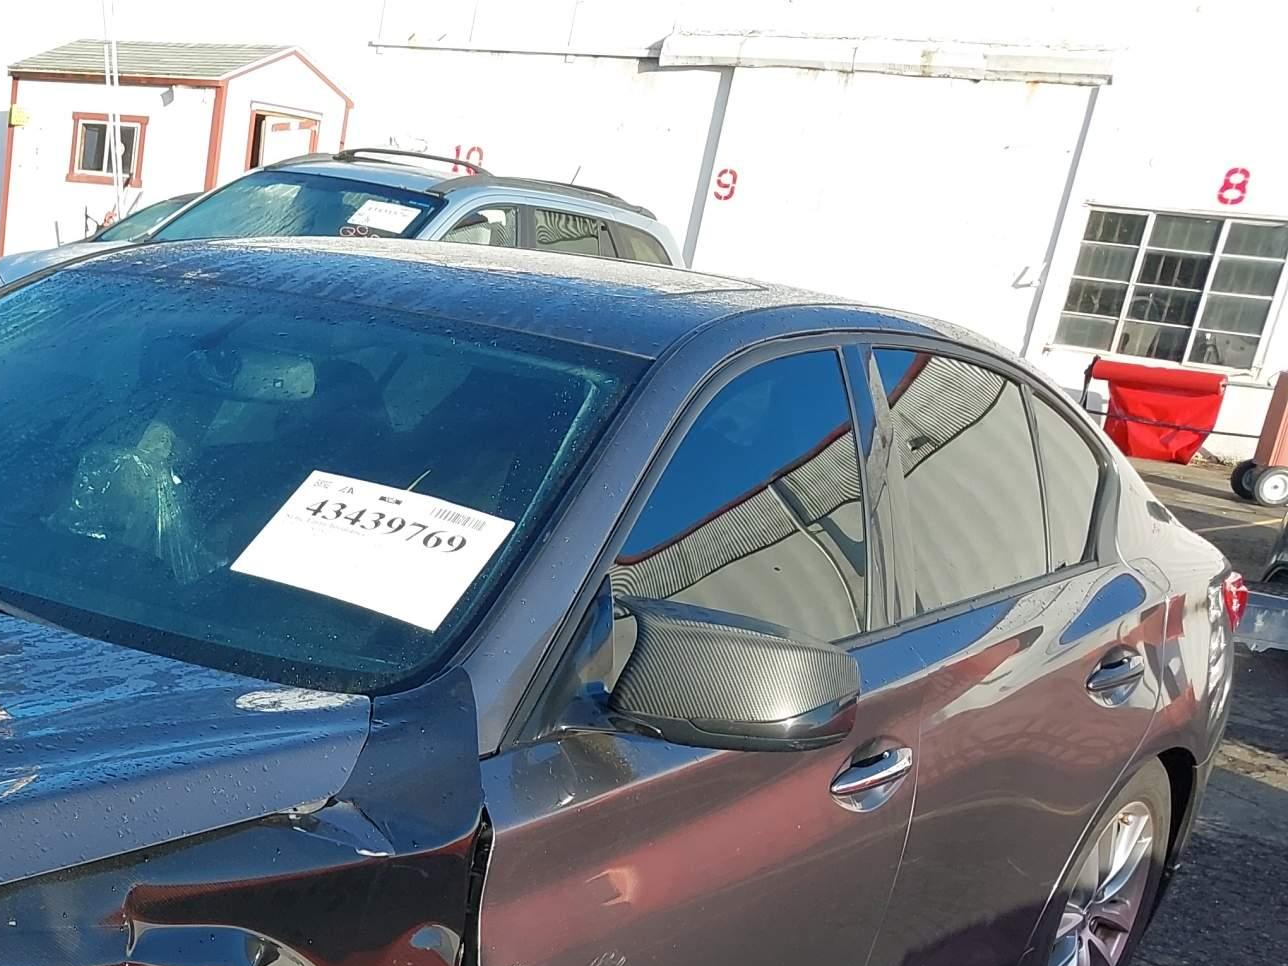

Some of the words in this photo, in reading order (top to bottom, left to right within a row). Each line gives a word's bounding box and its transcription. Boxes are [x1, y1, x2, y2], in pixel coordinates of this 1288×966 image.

[713, 168, 738, 201] 9
[1217, 167, 1250, 205] 8
[306, 499, 467, 553] 43439769
